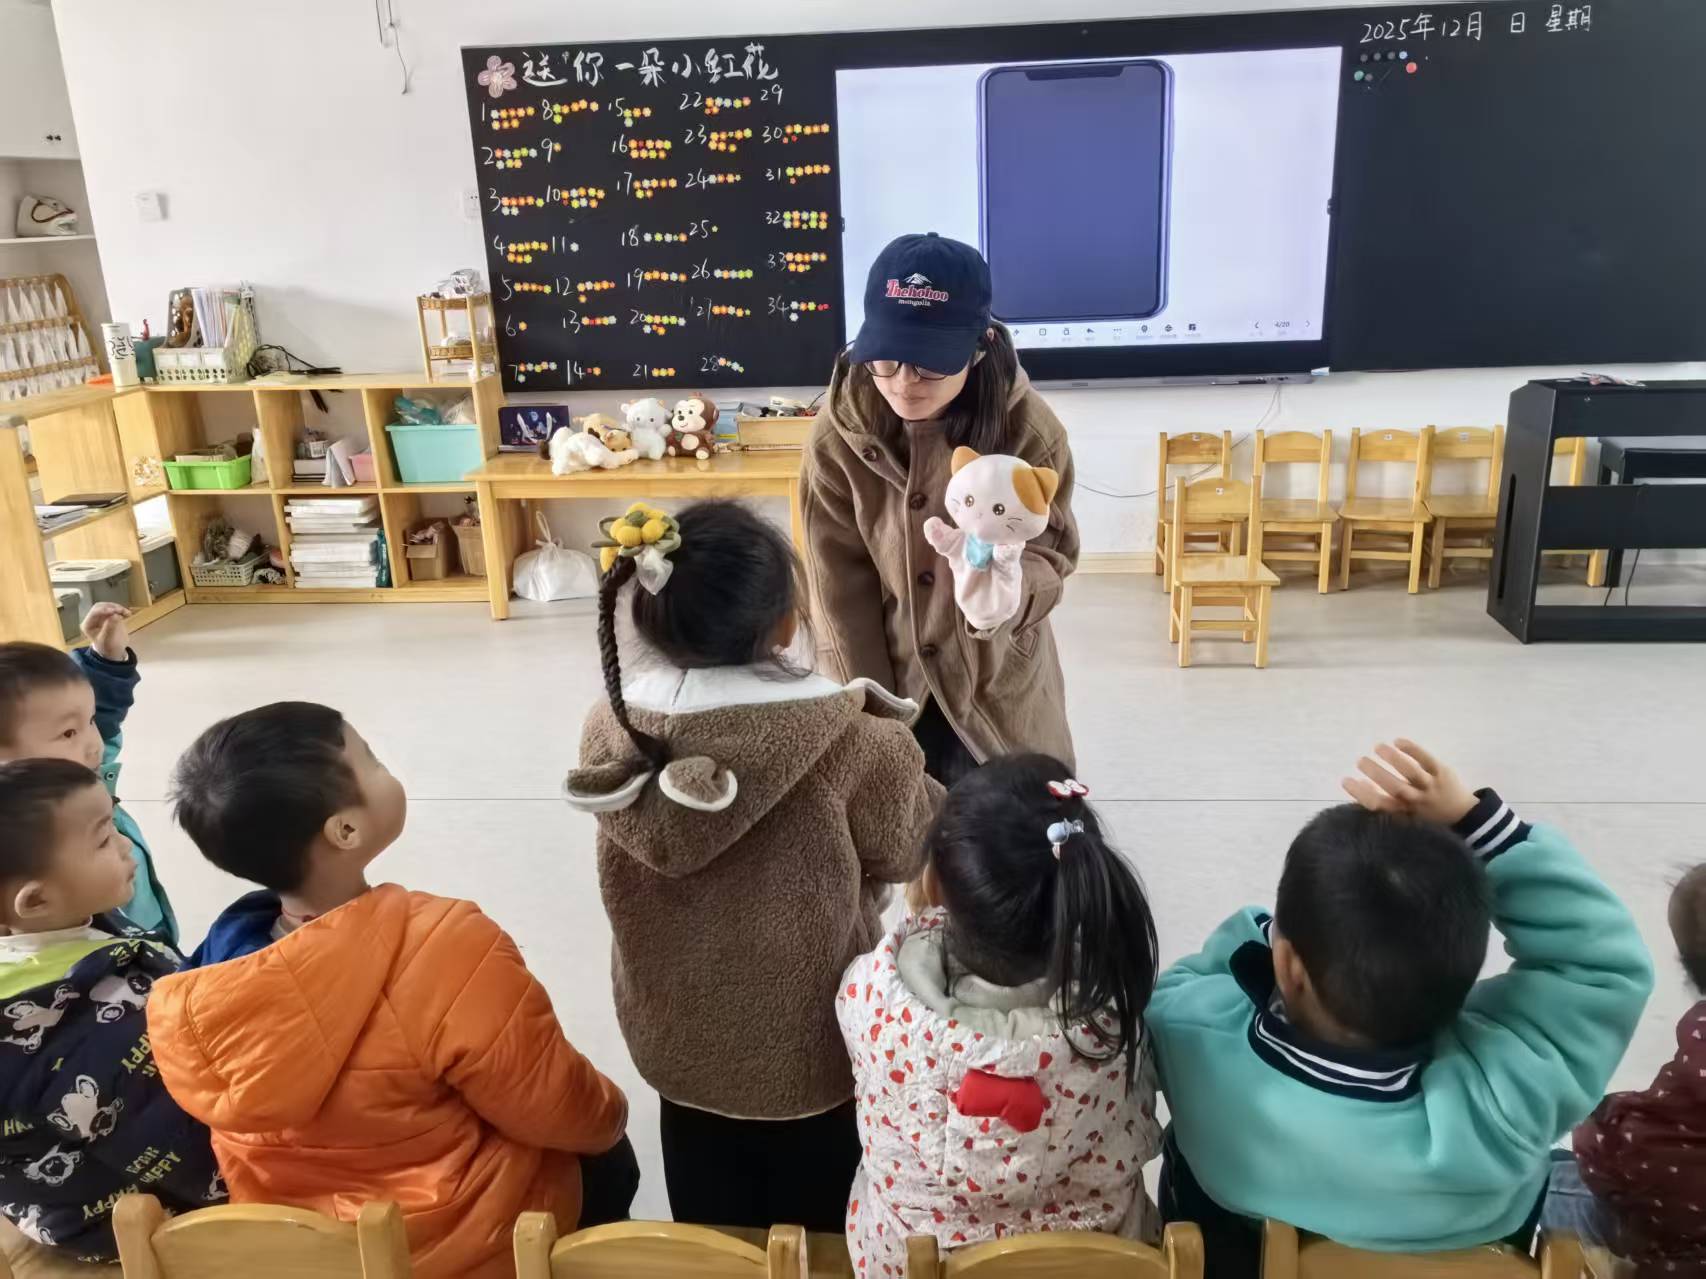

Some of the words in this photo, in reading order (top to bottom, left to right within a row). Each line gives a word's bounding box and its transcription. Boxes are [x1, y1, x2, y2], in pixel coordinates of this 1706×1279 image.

[1360, 11, 1482, 43] 2025年12月
[1510, 12, 1525, 34] 日
[1545, 4, 1591, 33] 星期
[522, 42, 779, 88] 送你一朵小红花
[679, 91, 702, 110] 22
[760, 84, 784, 105] 29
[542, 99, 553, 120] 8
[608, 97, 625, 117] 15
[612, 133, 628, 153] 16
[684, 124, 707, 144] 23
[762, 125, 783, 143] 30
[481, 146, 495, 165] 2
[541, 138, 553, 163] 9
[617, 172, 633, 196] 17
[685, 167, 708, 190] 24
[765, 167, 781, 181] 31
[489, 187, 501, 212] 3
[546, 185, 560, 203] 10
[765, 211, 782, 225] 32
[621, 228, 639, 247] 18
[689, 219, 709, 239] 25
[493, 235, 506, 256] 4
[552, 236, 565, 253] 11
[691, 258, 710, 280] 26
[768, 251, 787, 271] 33
[501, 274, 512, 301] 5
[556, 277, 573, 296] 12
[627, 267, 643, 292] 19
[630, 308, 646, 325] 20
[697, 297, 712, 321] 27
[768, 294, 789, 319] 34
[505, 314, 516, 337] 6
[563, 309, 581, 334] 13
[507, 364, 518, 382] 7
[567, 359, 585, 385] 14
[632, 364, 648, 380] 21
[701, 355, 719, 372] 28
